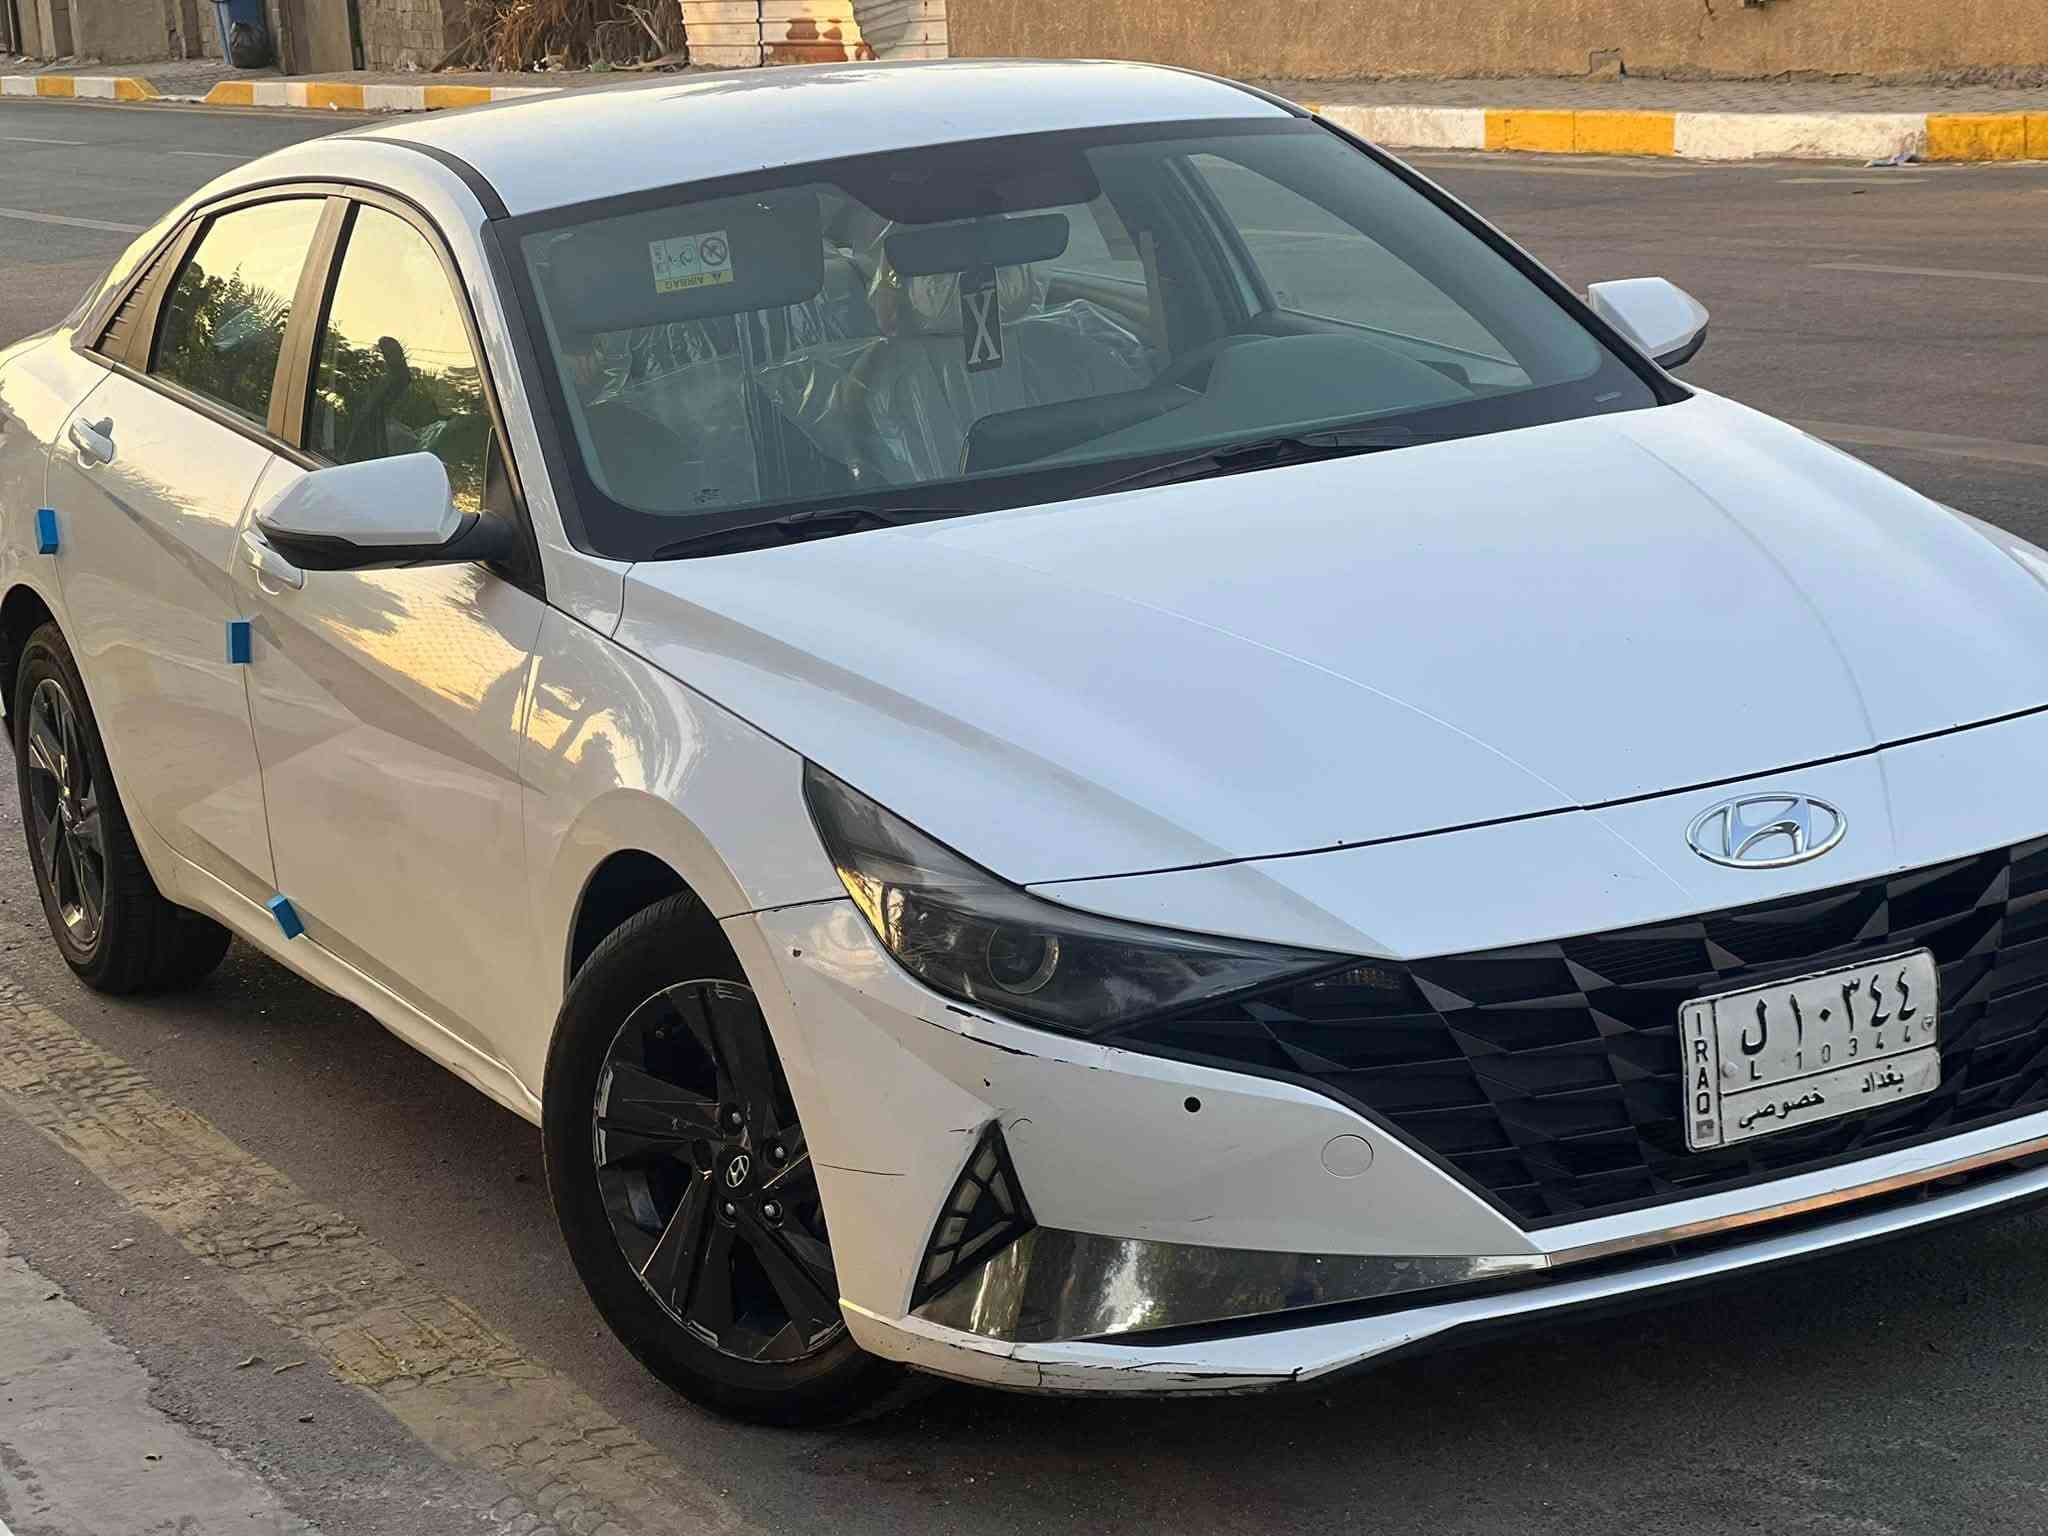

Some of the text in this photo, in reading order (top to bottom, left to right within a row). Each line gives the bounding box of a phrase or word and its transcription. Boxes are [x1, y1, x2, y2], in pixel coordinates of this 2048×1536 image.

[1693, 1011, 1711, 1115] IRAQ
[1738, 1064, 1905, 1130] بغداد خصوصي
